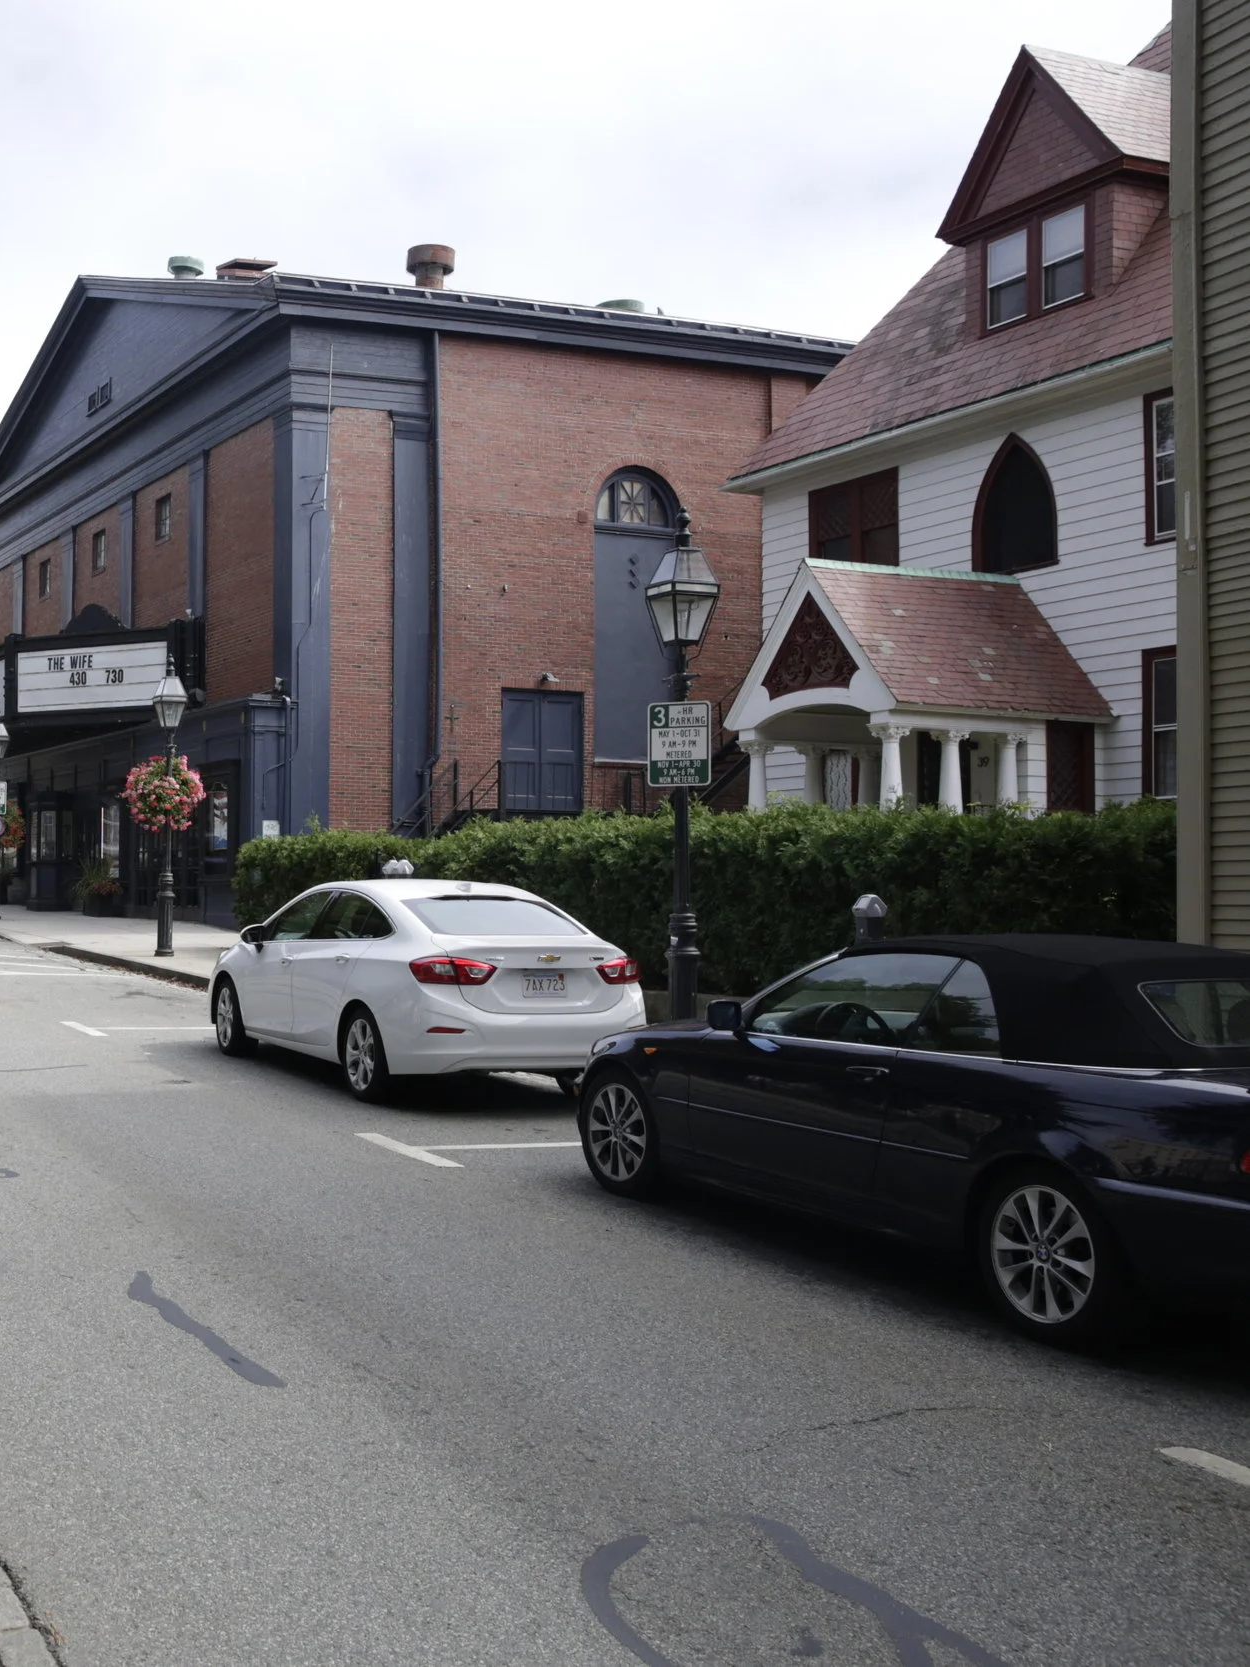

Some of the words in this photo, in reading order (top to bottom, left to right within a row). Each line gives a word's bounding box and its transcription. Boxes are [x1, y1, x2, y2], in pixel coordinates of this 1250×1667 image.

[47, 656, 65, 671] THE
[70, 654, 94, 669] WIFE
[69, 671, 87, 686] 430
[105, 668, 124, 684] 730
[653, 706, 666, 727] 3
[670, 716, 706, 725] PARKING
[658, 729, 670, 738] MAY
[693, 729, 700, 737] 31
[661, 740, 666, 748] 9
[688, 740, 697, 748] PM
[666, 750, 692, 759] METERED
[657, 760, 670, 768] NOV
[977, 756, 990, 768] 39
[673, 775, 700, 784] METERED
